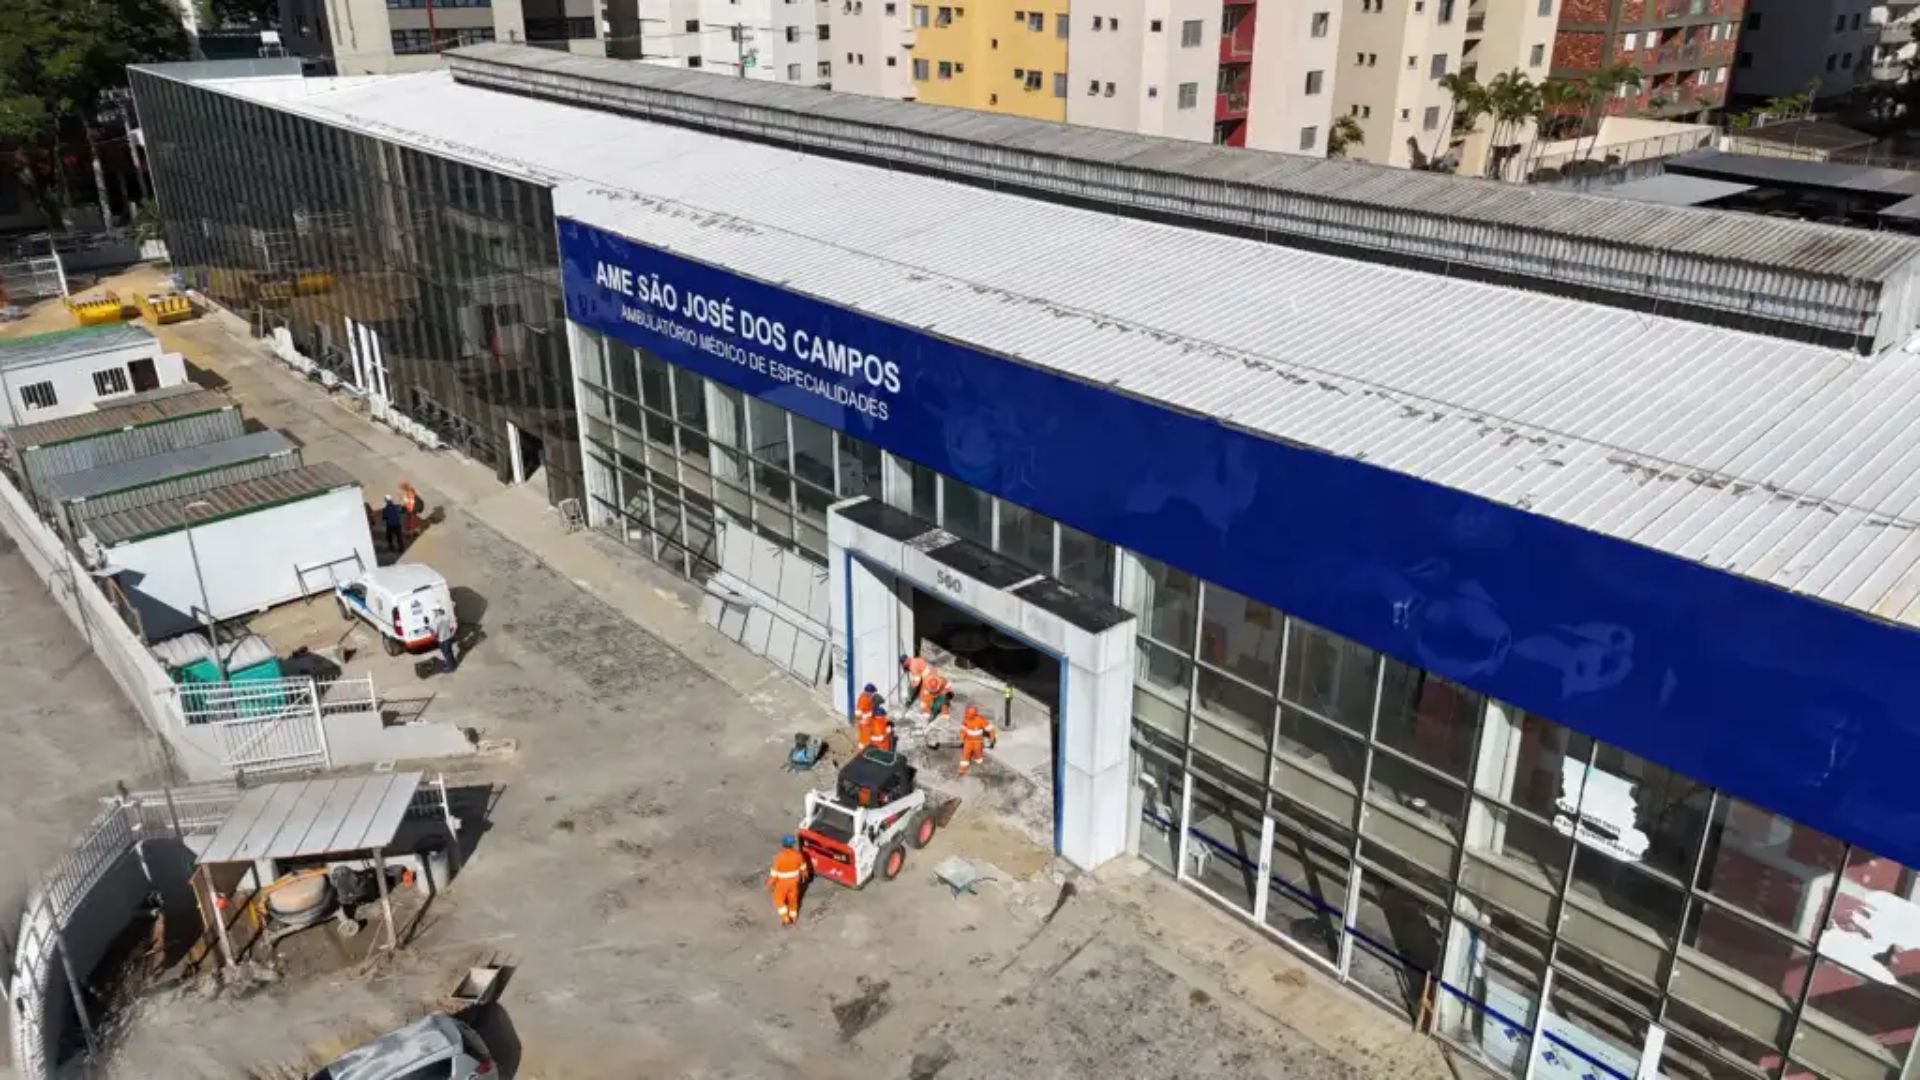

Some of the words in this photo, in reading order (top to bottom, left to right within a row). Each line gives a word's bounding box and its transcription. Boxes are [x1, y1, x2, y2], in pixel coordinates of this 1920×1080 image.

[596, 260, 633, 296] AME
[637, 272, 678, 311] SÃO
[682, 291, 736, 334] JOSÉ
[740, 309, 787, 351] DOS
[793, 329, 901, 394] CAMPOS
[621, 304, 698, 347] AMBULATÓRIO
[699, 332, 747, 366] MÉDICO
[749, 352, 767, 374] DE
[769, 359, 889, 421] ESPECIALIDADES
